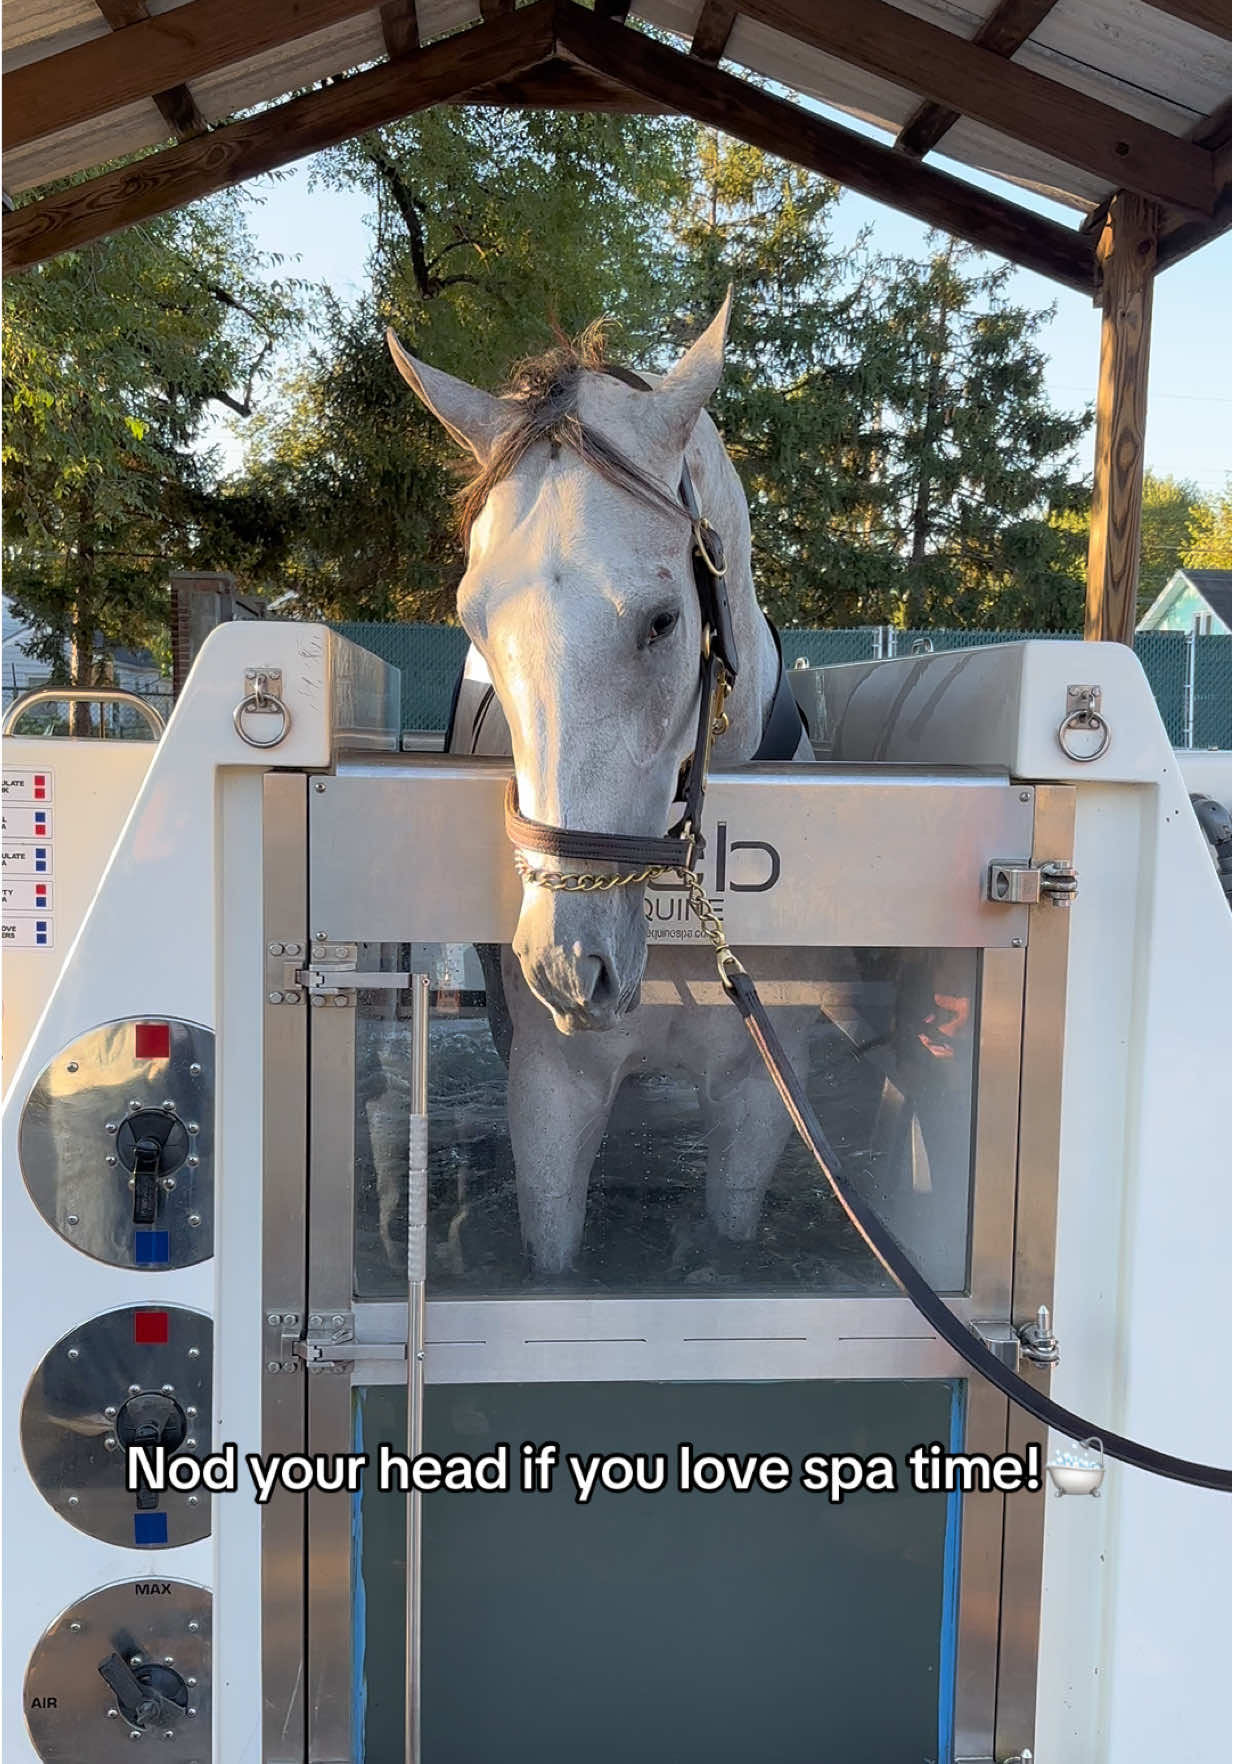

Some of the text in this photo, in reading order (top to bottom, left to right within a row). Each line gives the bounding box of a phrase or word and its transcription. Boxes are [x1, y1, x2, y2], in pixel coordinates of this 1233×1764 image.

[644, 898, 725, 922] QUINE
[135, 1583, 173, 1595] MAX
[31, 1697, 57, 1709] AIR
